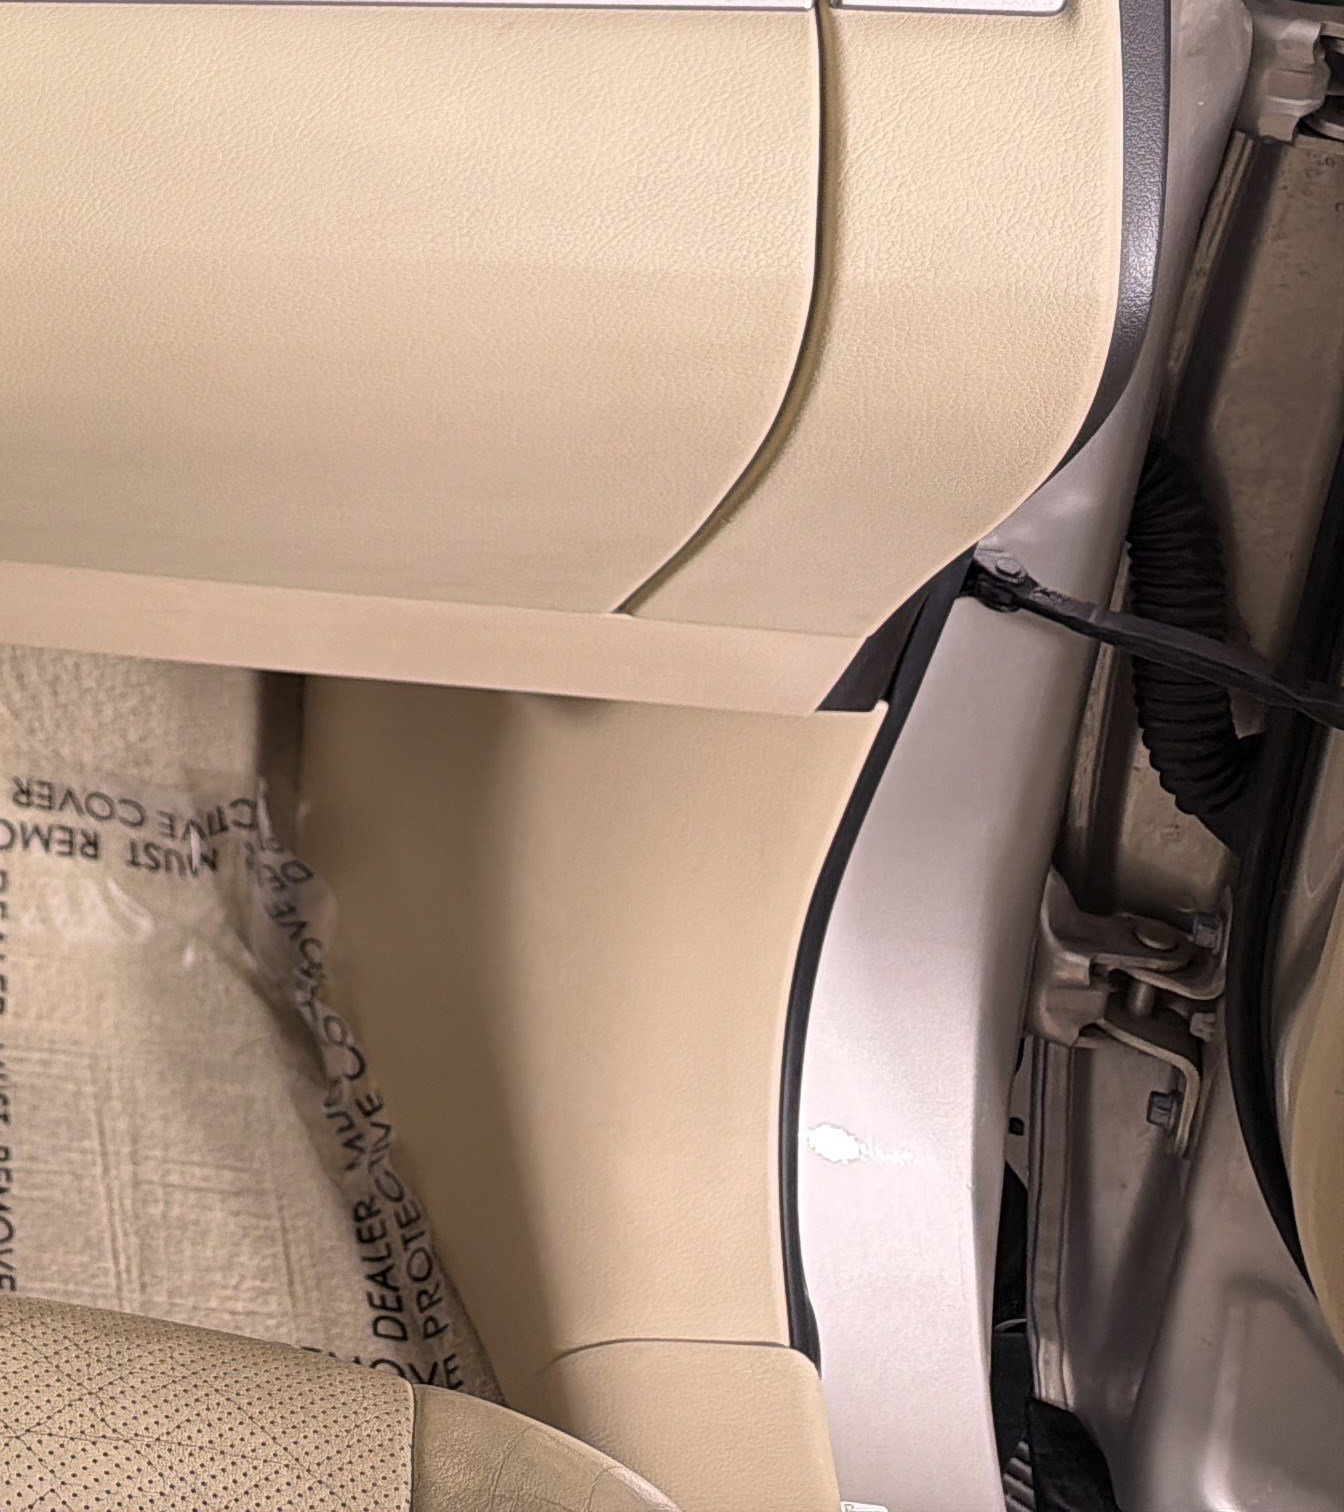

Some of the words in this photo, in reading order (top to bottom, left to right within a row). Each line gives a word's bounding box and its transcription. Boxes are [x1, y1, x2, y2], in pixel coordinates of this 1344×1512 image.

[12, 775, 146, 831] COVER
[124, 840, 219, 878] MUST
[353, 1192, 410, 1344] DEALER
